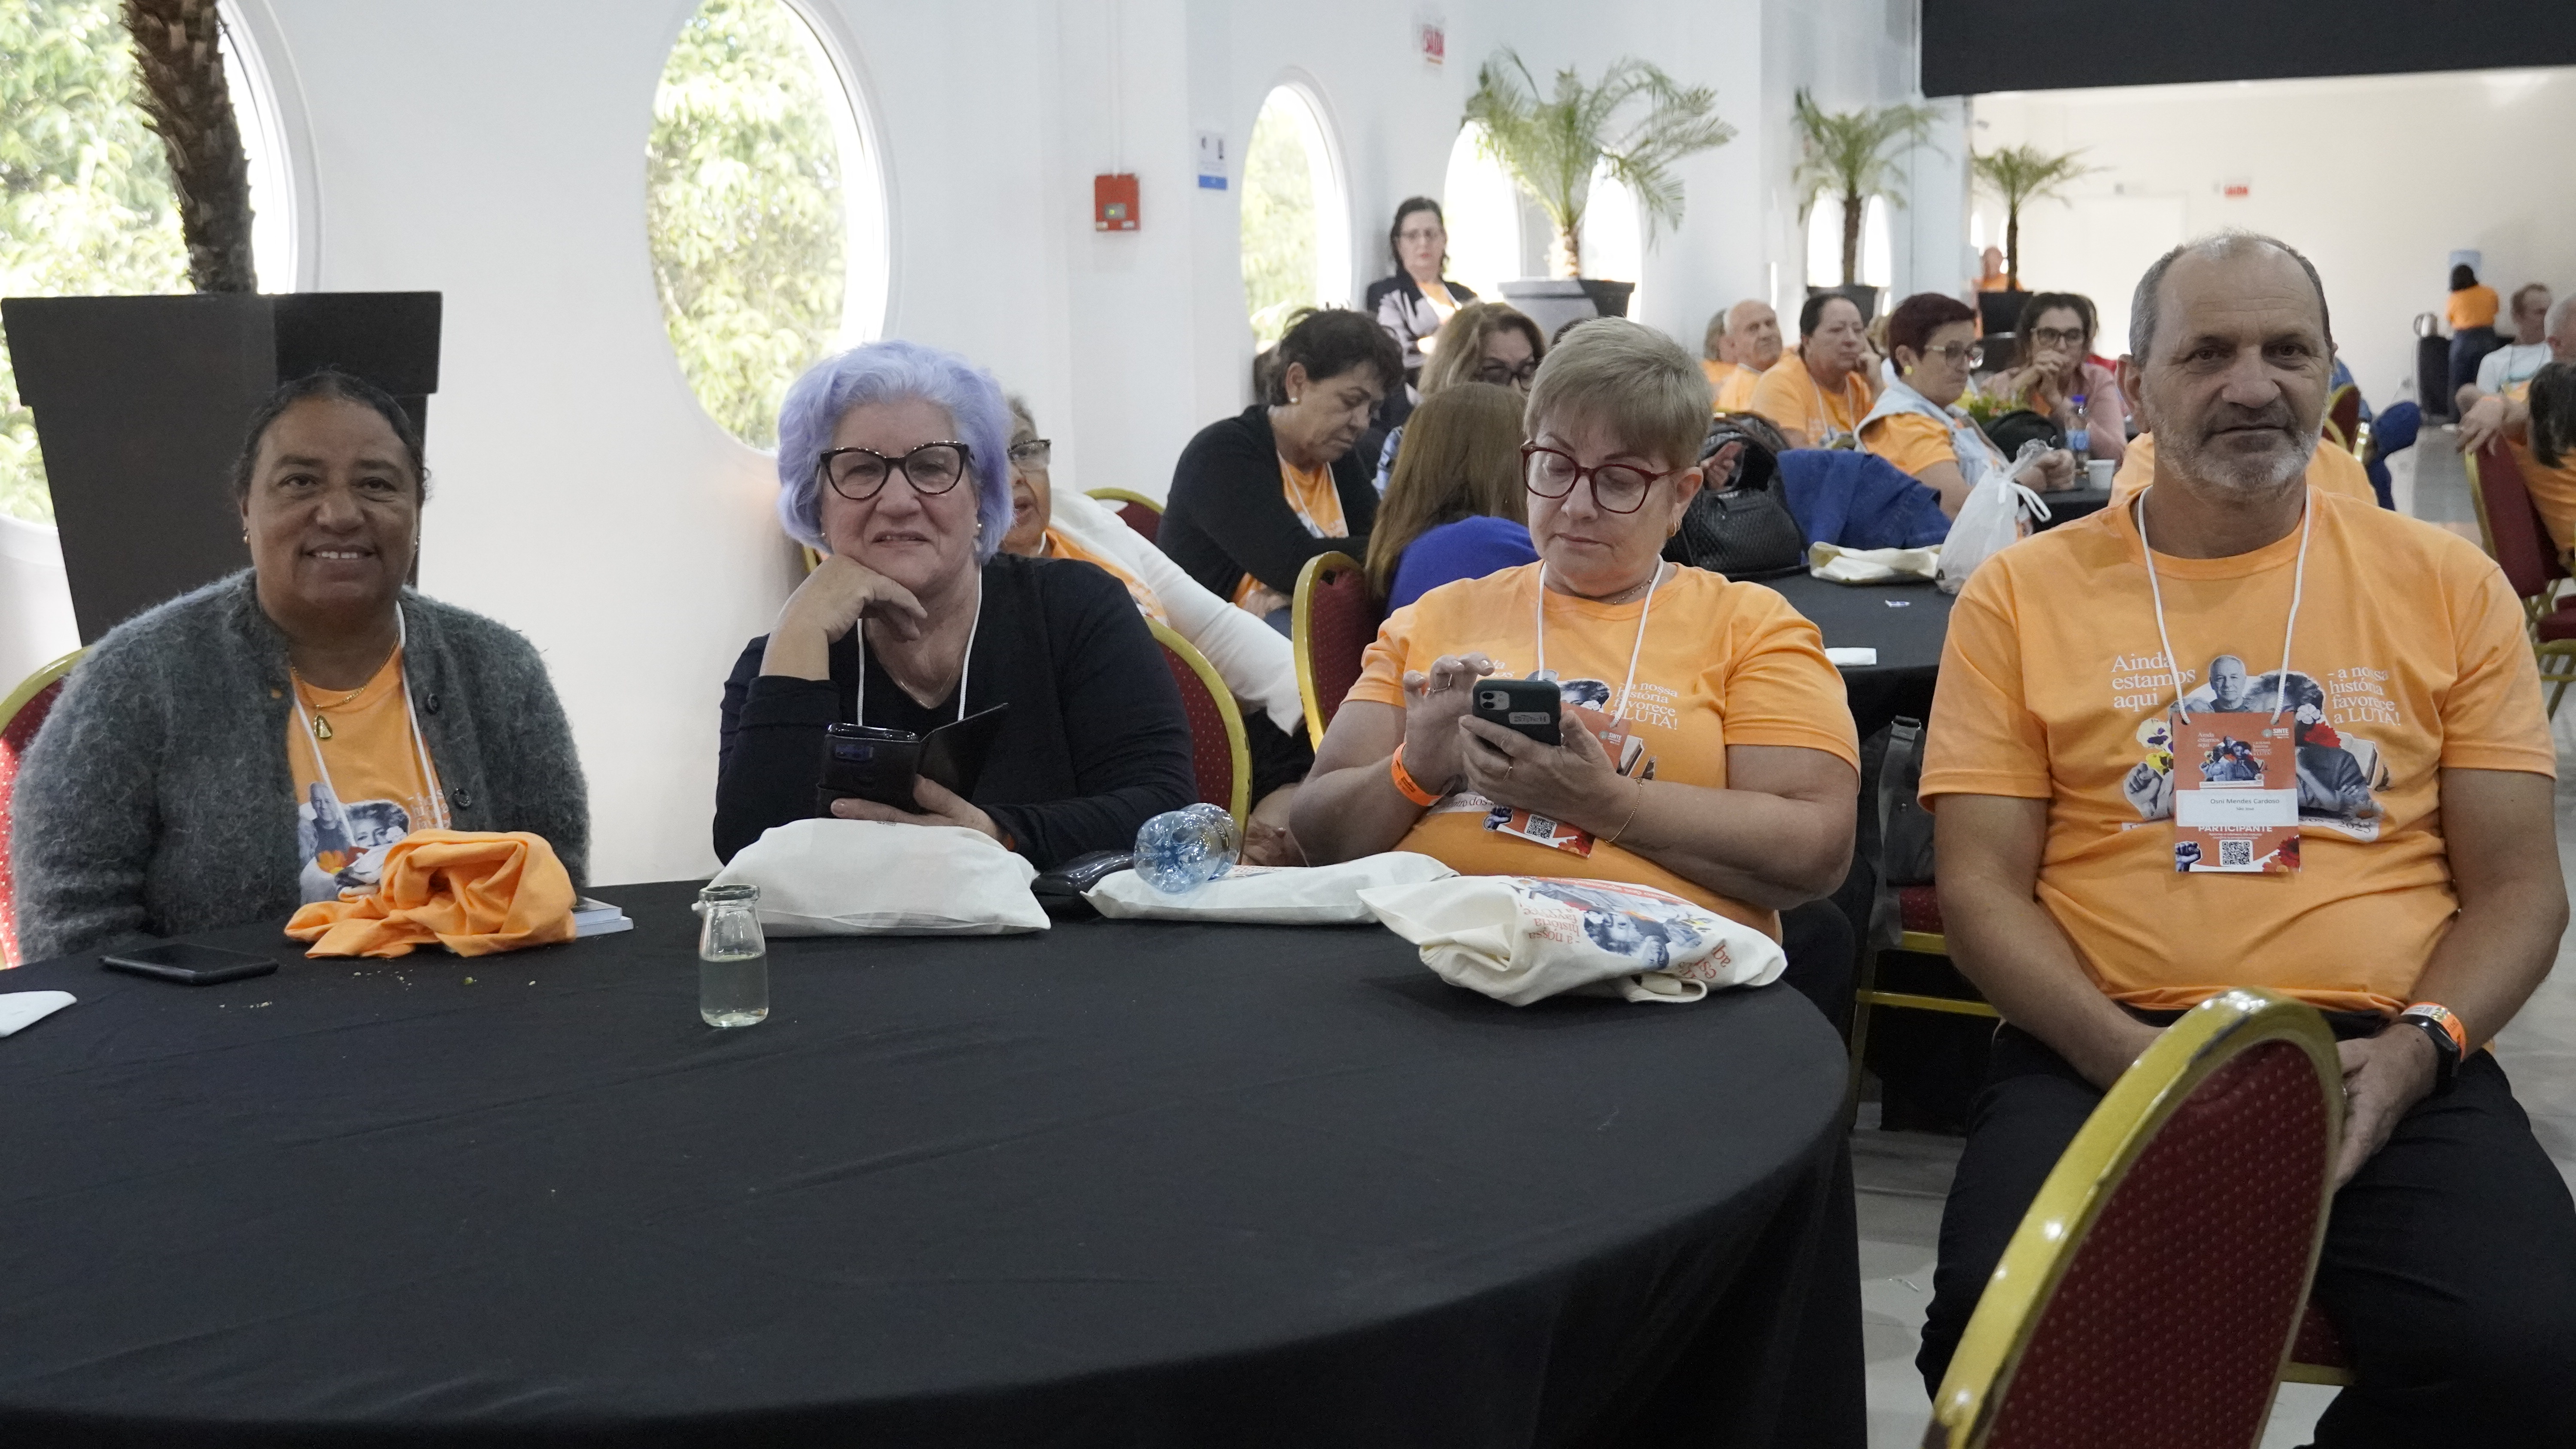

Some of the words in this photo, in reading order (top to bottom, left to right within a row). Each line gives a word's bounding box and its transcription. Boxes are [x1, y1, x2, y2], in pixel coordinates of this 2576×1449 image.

[2112, 669, 2196, 690] estamos
[2338, 669, 2347, 678] a
[1616, 687, 1669, 703] hstória
[1640, 682, 1678, 697] nossa
[1613, 697, 1676, 716] fvorece
[2114, 687, 2159, 712] aqui
[2332, 694, 2395, 711] favorece
[1622, 709, 1678, 730] LUTA!
[2334, 713, 2344, 724] a
[2346, 707, 2401, 726] LUTA!
[1608, 732, 1622, 740] SINTE
[1469, 797, 1487, 805] dos
